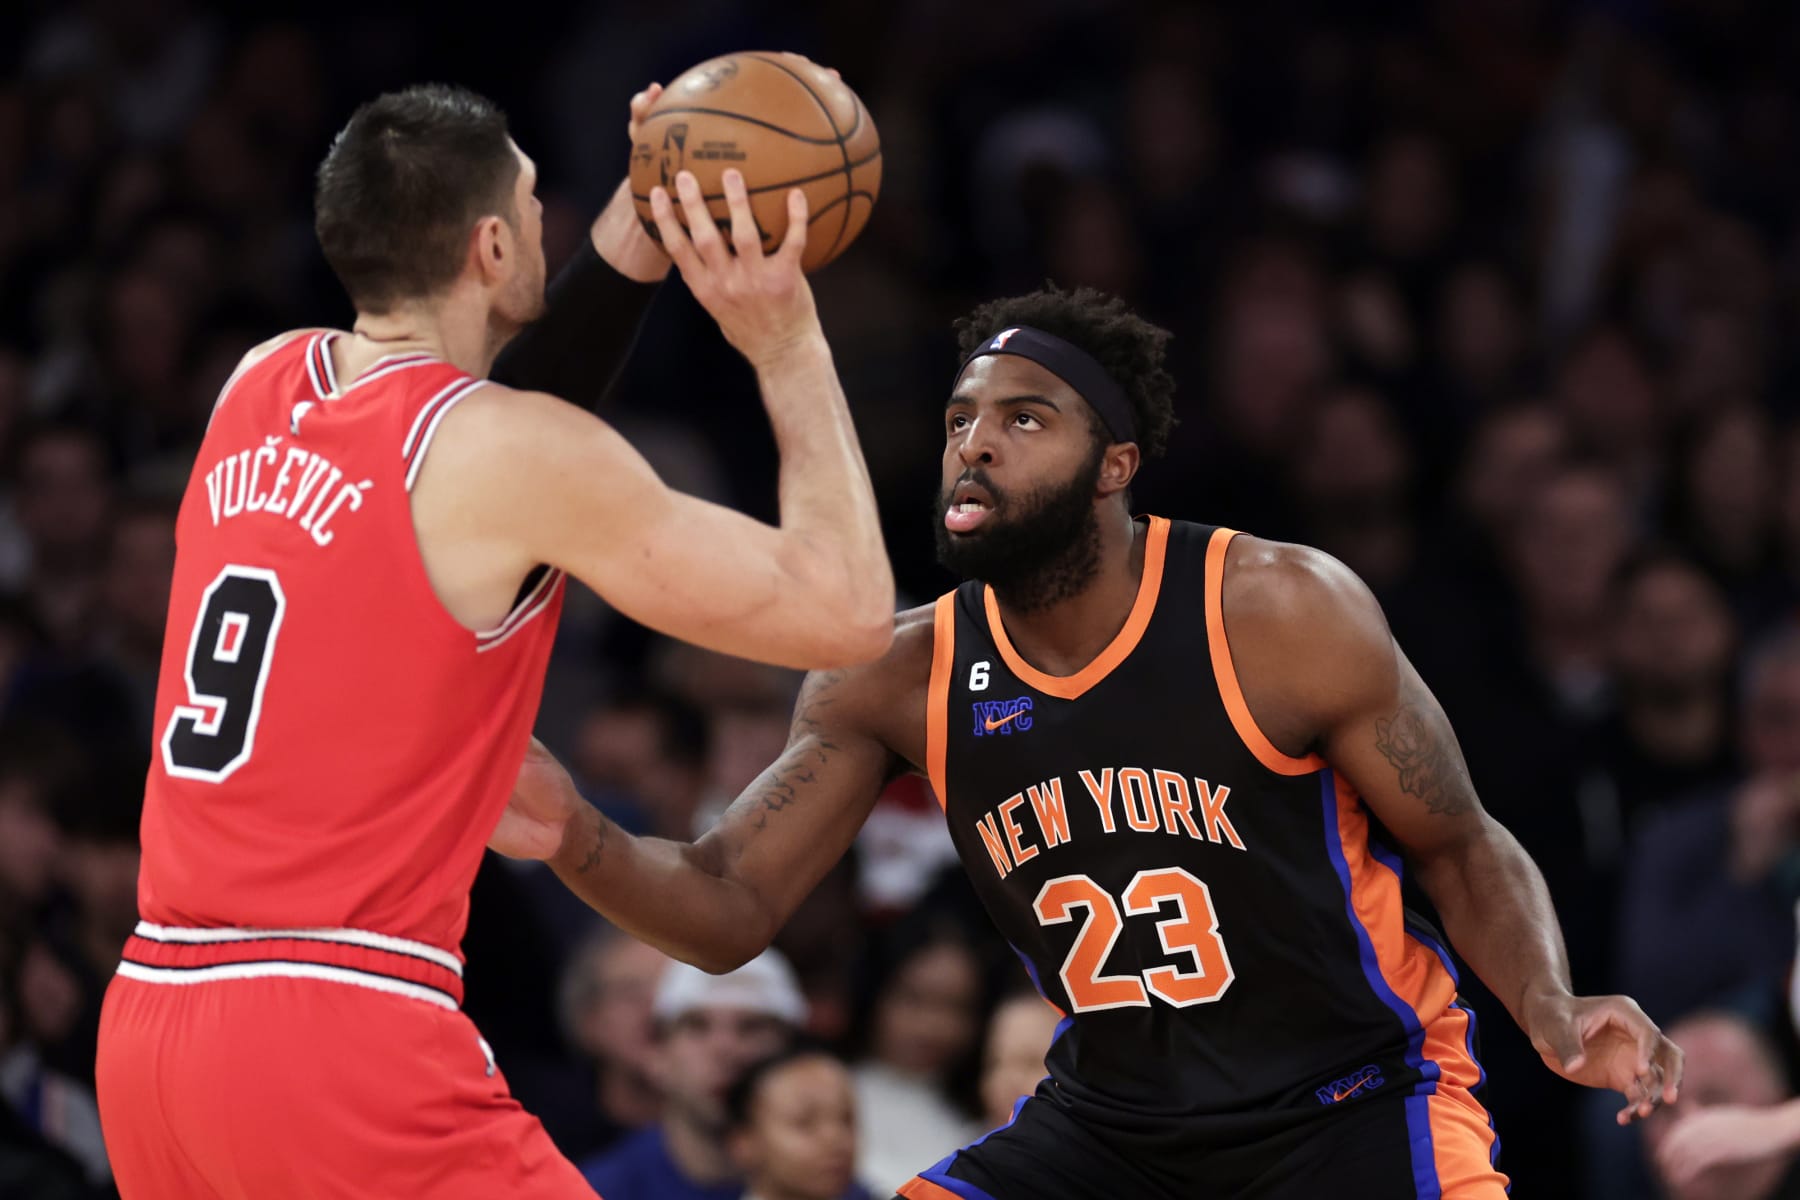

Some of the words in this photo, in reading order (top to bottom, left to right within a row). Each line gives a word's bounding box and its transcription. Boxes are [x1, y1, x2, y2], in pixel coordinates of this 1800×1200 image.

[205, 435, 373, 546] VUČEVIĆ
[161, 564, 286, 784] 9
[969, 660, 991, 692] 6
[972, 695, 1033, 736] NYC
[976, 776, 1072, 880] NEW
[1078, 767, 1247, 851] YORK
[1032, 866, 1236, 1014] 23
